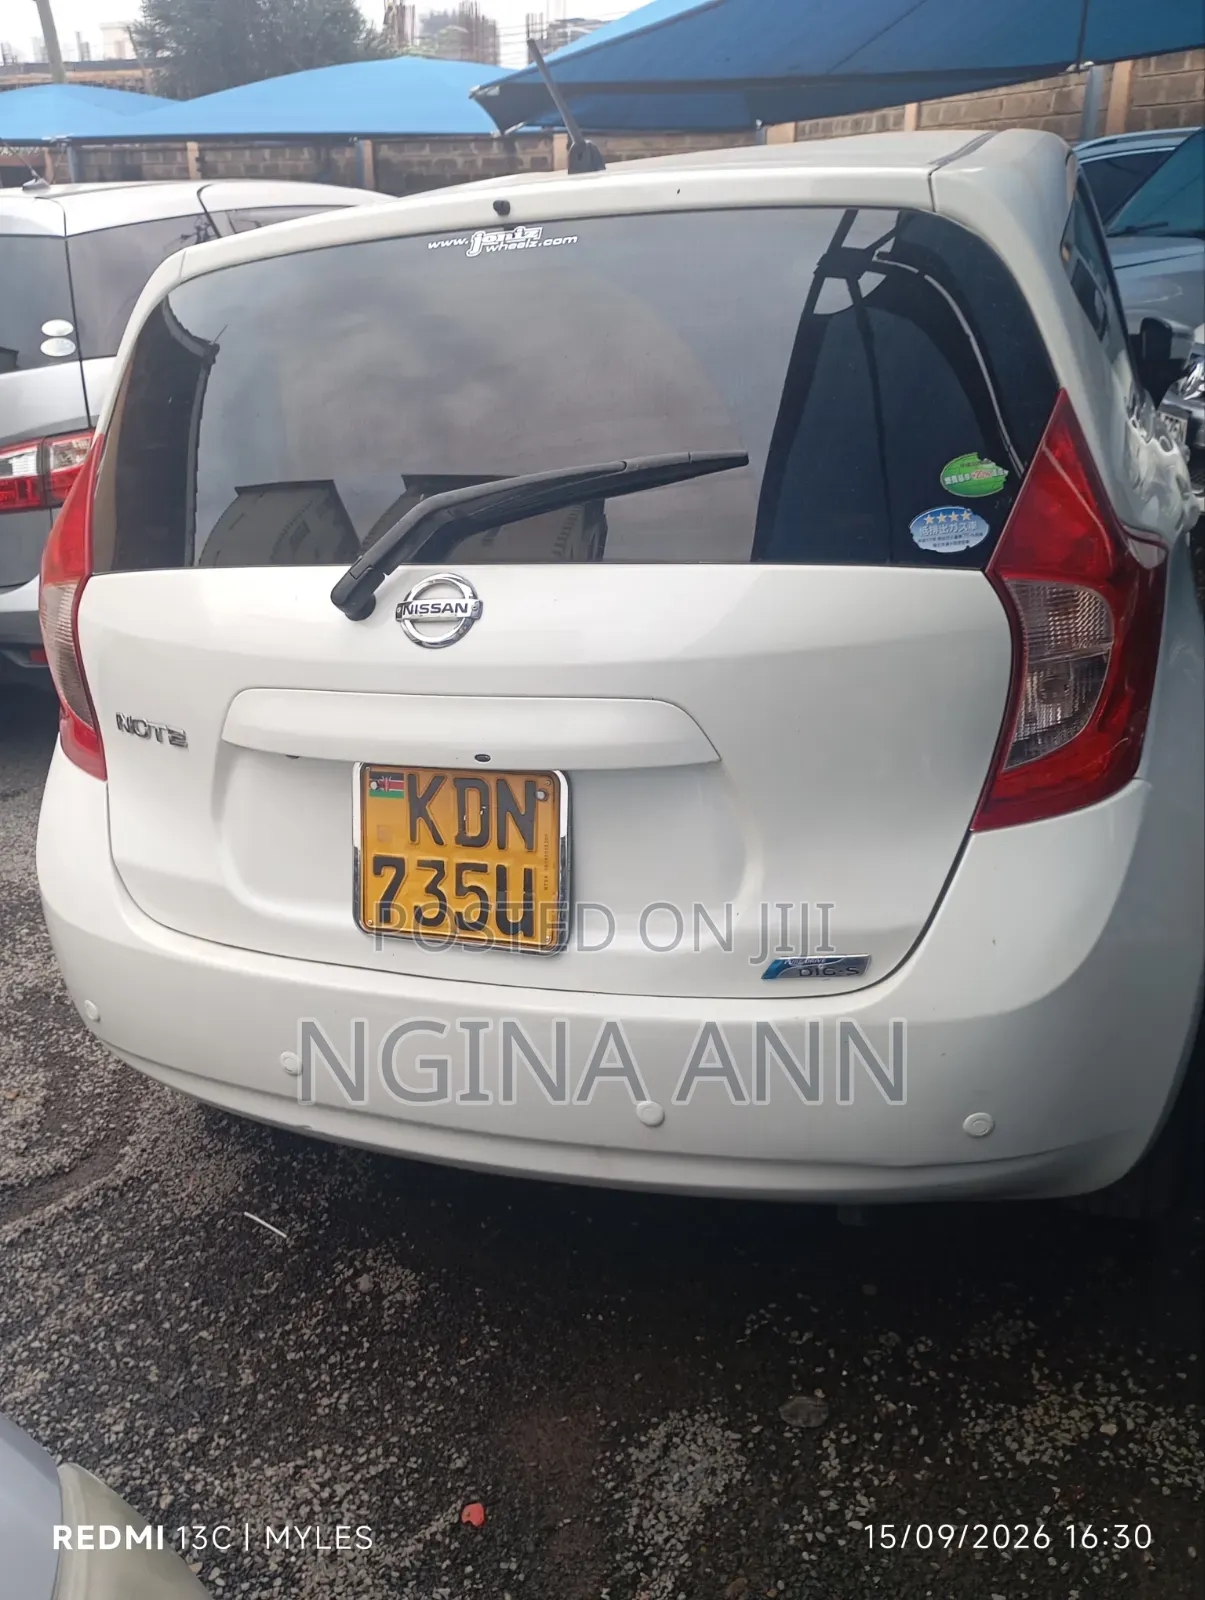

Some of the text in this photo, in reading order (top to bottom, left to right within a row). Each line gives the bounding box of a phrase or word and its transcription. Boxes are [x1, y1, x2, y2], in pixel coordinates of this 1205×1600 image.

[403, 602, 468, 616] NISSAN
[115, 711, 188, 748] NOTE
[407, 772, 537, 852] KDN
[372, 854, 535, 938] 735U
[799, 966, 860, 977] DIG-S
